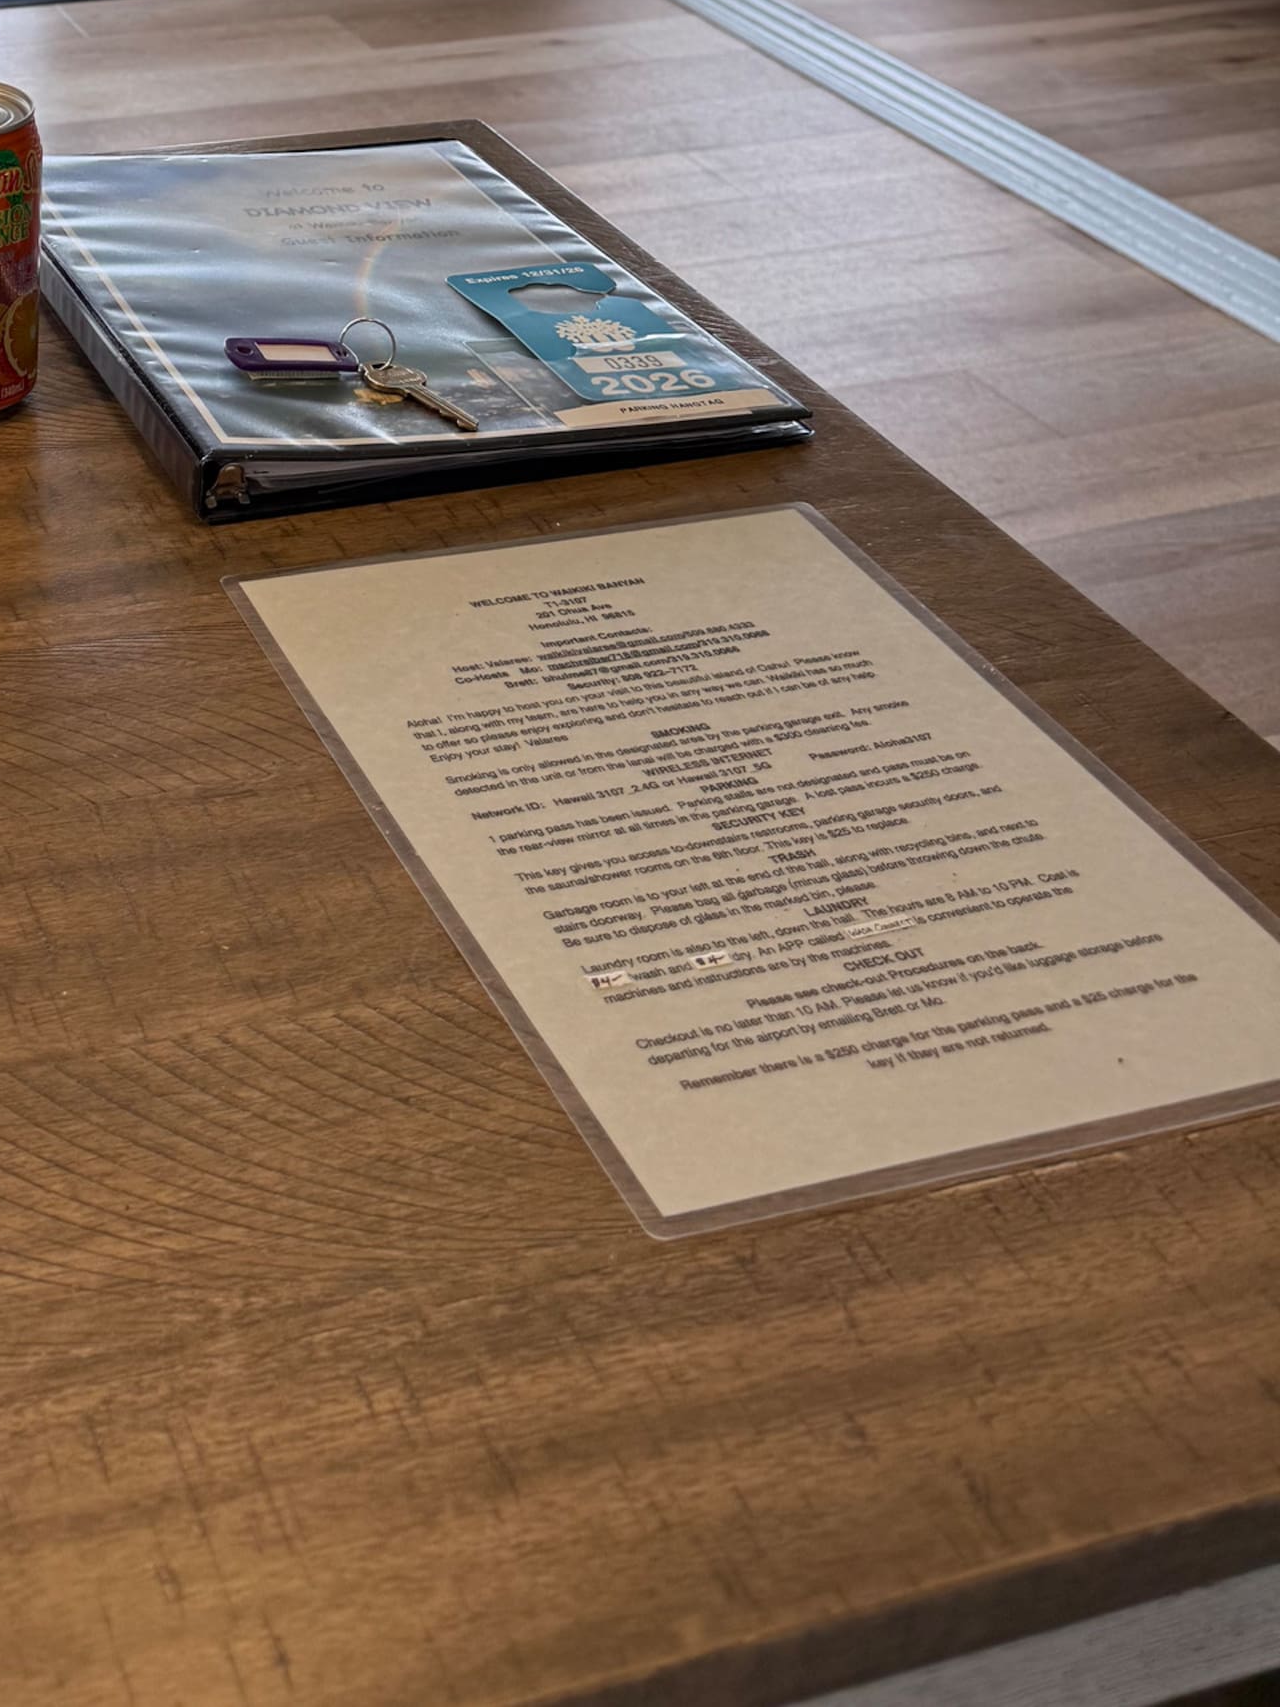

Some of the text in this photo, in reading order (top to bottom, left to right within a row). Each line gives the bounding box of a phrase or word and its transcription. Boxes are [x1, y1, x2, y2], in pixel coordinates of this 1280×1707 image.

[243, 198, 432, 218] DIAMOND VIEW
[343, 229, 460, 244] Information
[464, 274, 519, 285] Expires
[604, 354, 663, 370] 0339
[591, 369, 716, 396] 2026
[619, 399, 725, 414] PARKING HANGTAG
[468, 593, 531, 606] WELCOME
[549, 584, 596, 595] WAIKIKI
[596, 577, 645, 589] BANYAN
[528, 618, 584, 630] Honolulu,
[535, 610, 555, 618] 201
[540, 627, 652, 647] Important Contacts:
[566, 677, 620, 690] Security:
[650, 722, 710, 737] SMOKING
[641, 747, 772, 775] WIRELESS INTERNET
[808, 744, 871, 759] Password:
[699, 776, 758, 792] PARKING
[711, 806, 805, 829] SECURITY KEY
[767, 848, 816, 862] TRASH
[803, 896, 868, 915] LAUNDRY
[629, 967, 666, 980] wash
[667, 961, 693, 973] and
[757, 947, 776, 956] An
[777, 939, 804, 952] APP
[807, 931, 845, 946] called
[927, 902, 993, 921] convenient
[990, 900, 1006, 908] to
[1006, 891, 1052, 906] operate
[1051, 886, 1073, 895] the
[843, 947, 924, 970] CHECK OUT
[603, 985, 666, 1003] machines
[667, 978, 693, 990] and
[692, 965, 766, 985] instructions
[767, 960, 789, 970] are
[788, 957, 806, 966] by
[806, 952, 829, 962] the
[745, 993, 793, 1008] Please
[793, 988, 819, 999] see
[820, 972, 889, 993] check-out
[887, 958, 966, 979] Procedures
[966, 954, 985, 963] on
[983, 949, 1008, 959] the
[647, 1046, 712, 1065] departing
[710, 1041, 730, 1051] for
[731, 1037, 754, 1047] the
[756, 1026, 799, 1043] airport
[796, 1024, 816, 1033] by
[817, 1012, 874, 1029] emailing
[871, 1004, 906, 1017] Brett
[906, 1001, 919, 1010] or
[679, 974, 1198, 1089] Remember there is a $250 charge for the parking pass and a $25 charge for the
[866, 1057, 894, 1068] key
[893, 1052, 907, 1062] if
[906, 1047, 940, 1060] they
[940, 1042, 965, 1053] are
[964, 1035, 990, 1047] not
